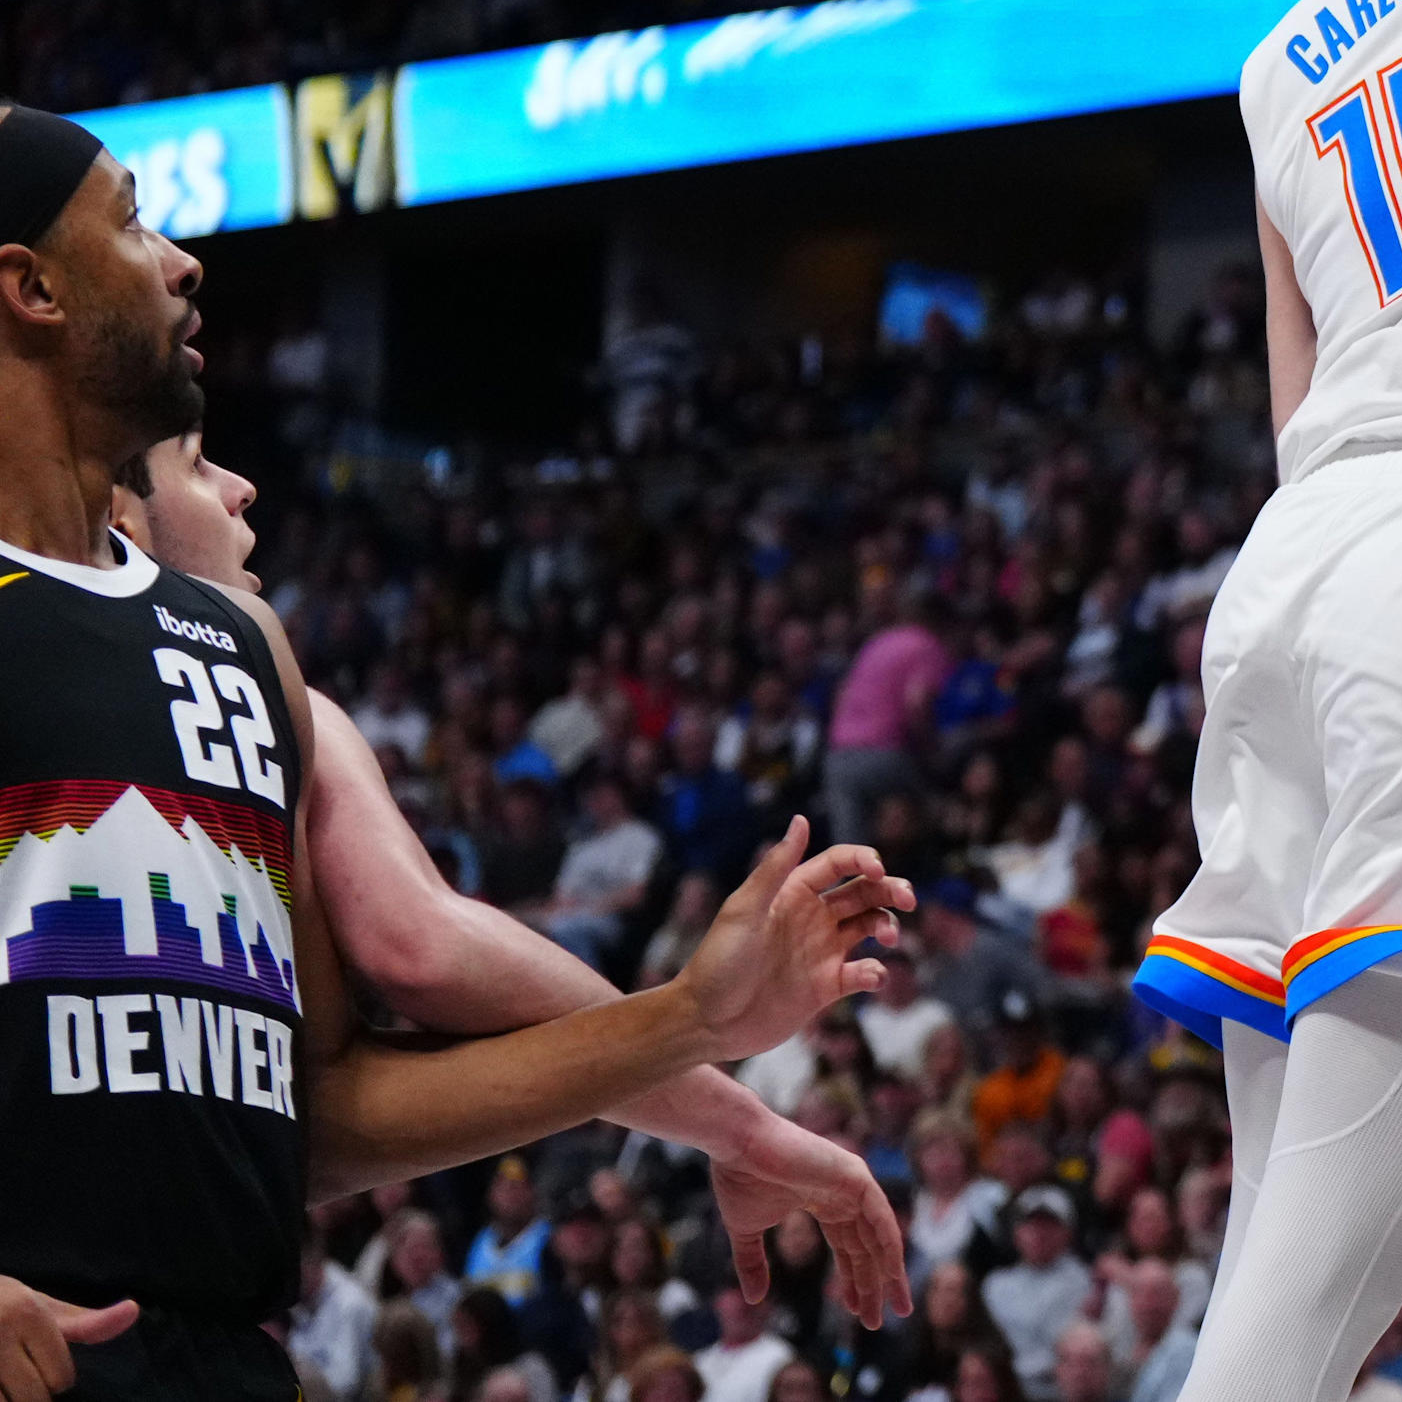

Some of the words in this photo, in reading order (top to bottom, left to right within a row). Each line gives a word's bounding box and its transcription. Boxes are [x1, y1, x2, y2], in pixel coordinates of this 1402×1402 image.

[152, 603, 238, 654] ibotta
[152, 647, 286, 810] 22
[47, 994, 297, 1121] DENVER
